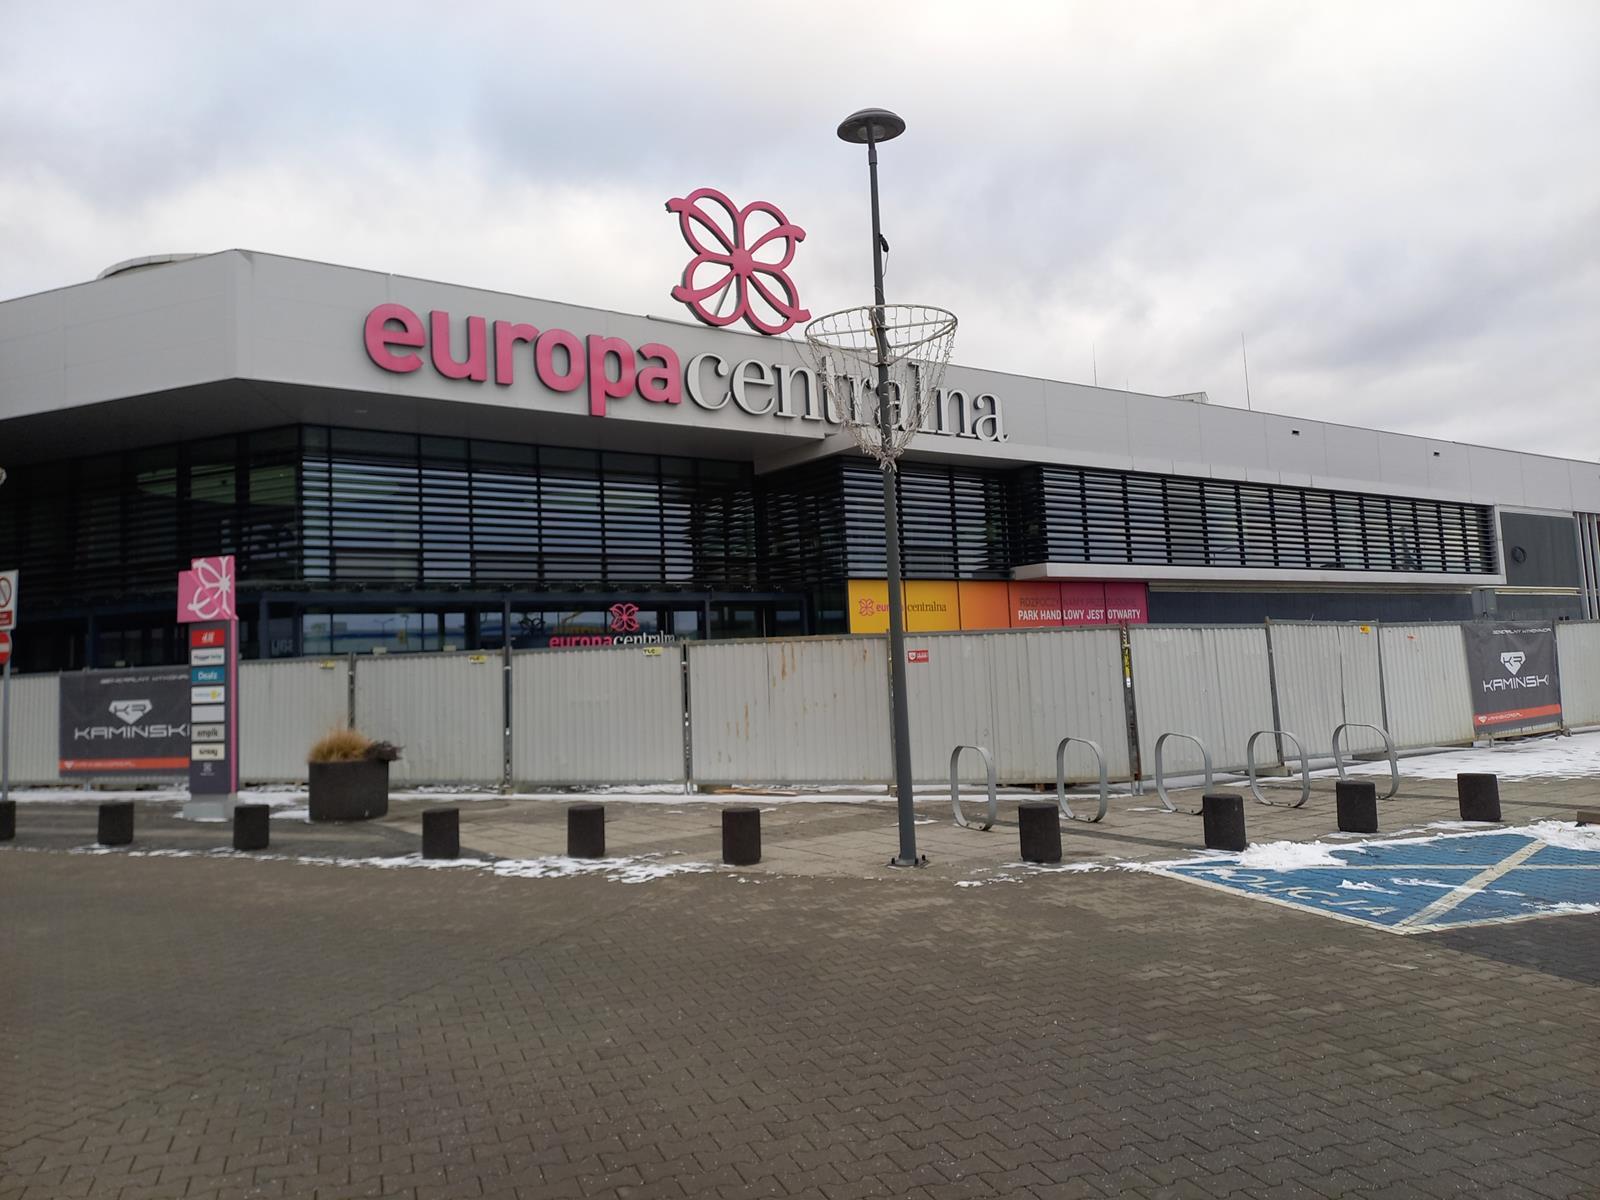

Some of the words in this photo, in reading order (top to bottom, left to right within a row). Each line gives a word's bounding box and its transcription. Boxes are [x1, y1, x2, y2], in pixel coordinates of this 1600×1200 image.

[1018, 610, 1039, 621] PARK
[1086, 609, 1105, 620] JEST
[1107, 608, 1141, 620] OTWARTY
[1194, 870, 1399, 917] OLICJA
